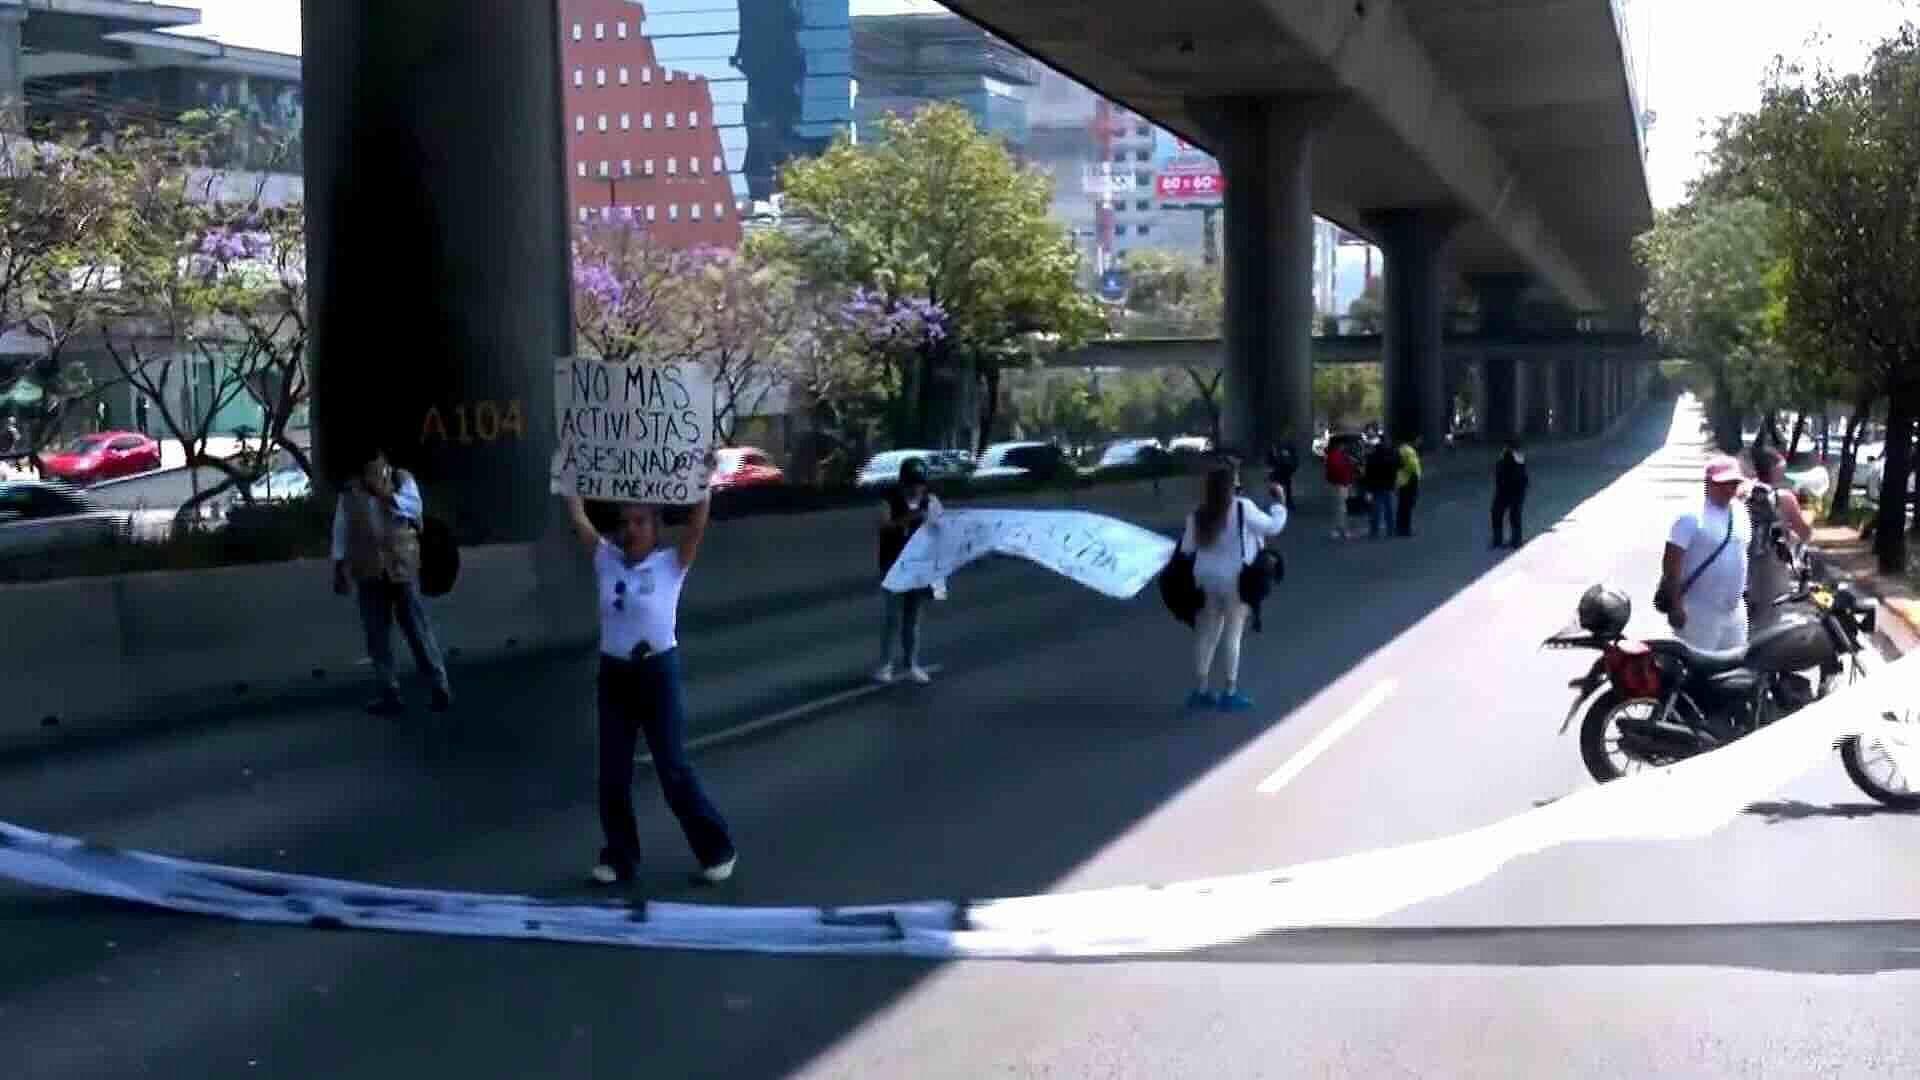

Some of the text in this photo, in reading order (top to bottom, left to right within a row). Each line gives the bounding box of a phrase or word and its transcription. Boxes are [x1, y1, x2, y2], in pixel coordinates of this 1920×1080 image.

[571, 360, 691, 410] NO MAS
[419, 400, 524, 445] A104
[561, 407, 701, 446] ACTIVISTAS
[576, 474, 688, 500] EN MEXICO
